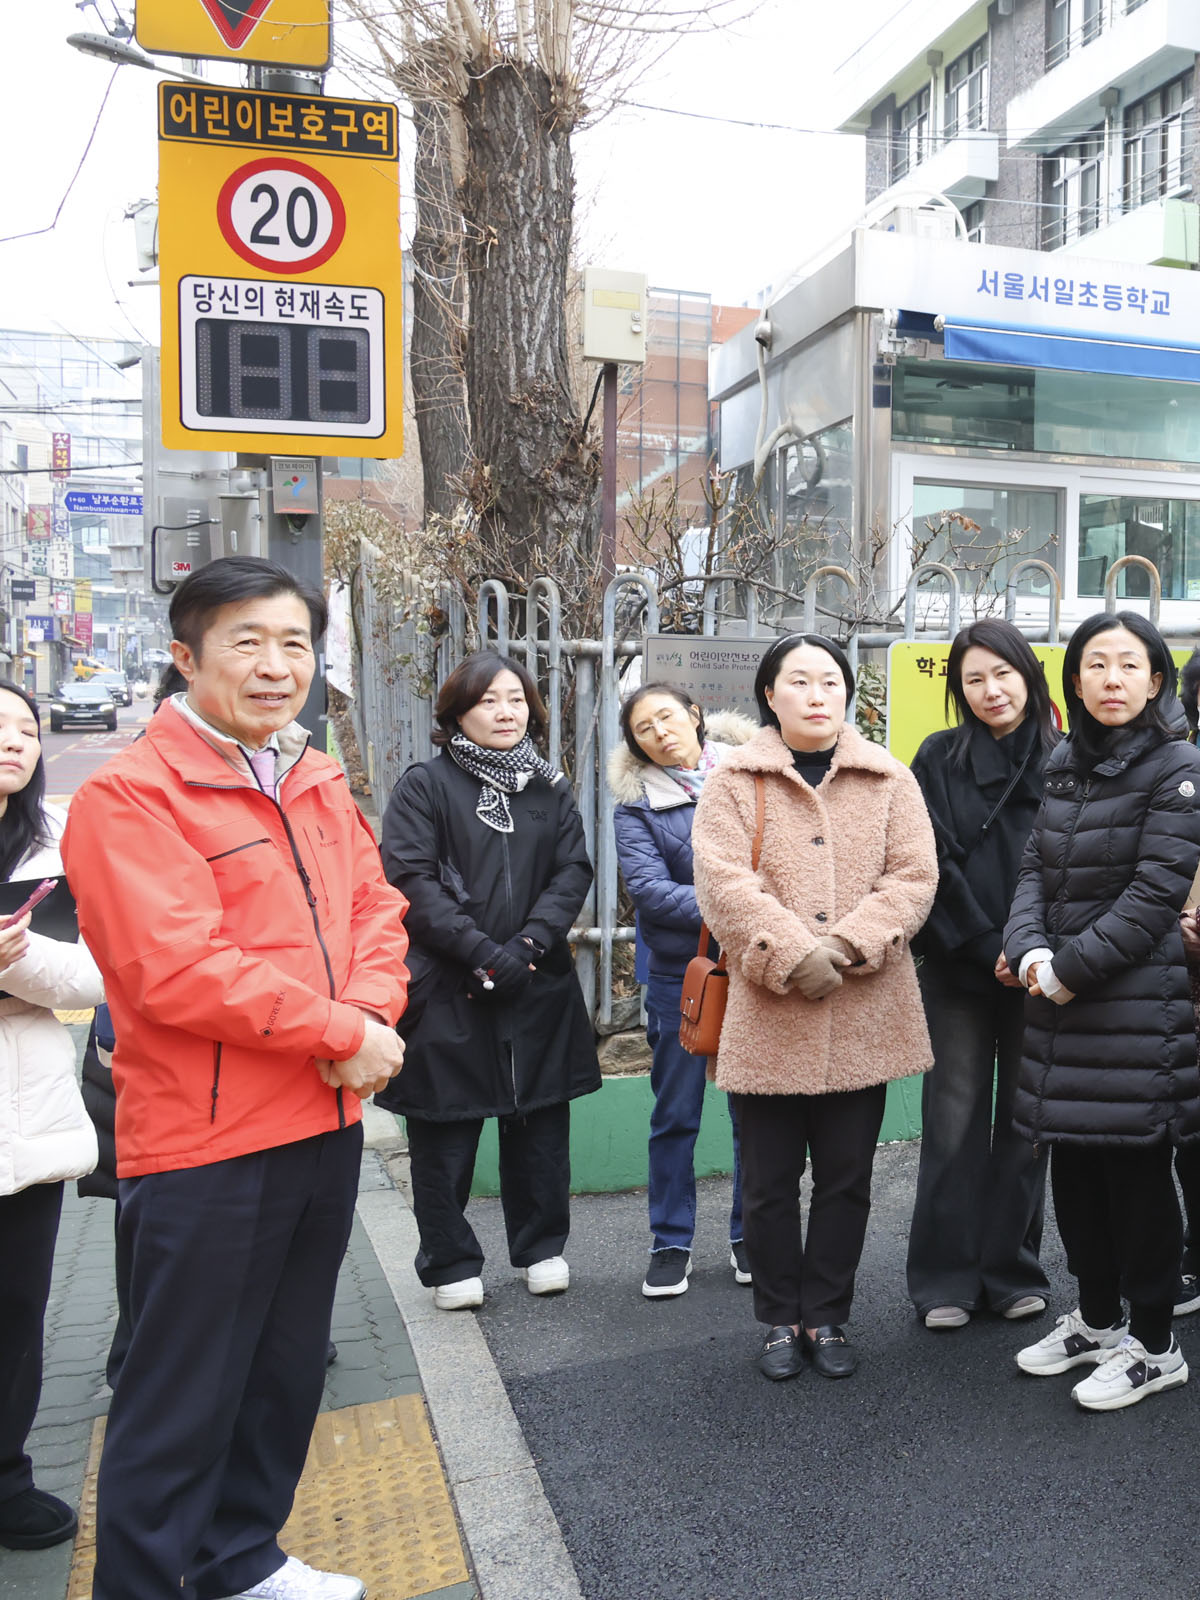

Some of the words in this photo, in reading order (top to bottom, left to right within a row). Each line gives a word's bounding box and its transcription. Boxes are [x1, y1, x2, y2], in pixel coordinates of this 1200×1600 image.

[169, 91, 389, 152] 어린이보호구역
[249, 183, 319, 249] 20
[193, 282, 264, 317] 당신의
[275, 287, 370, 322] 현재속도
[977, 269, 1170, 316] 서울서일초등학교
[73, 504, 140, 514] Nambusunhwan-ro
[173, 561, 191, 572] 3M
